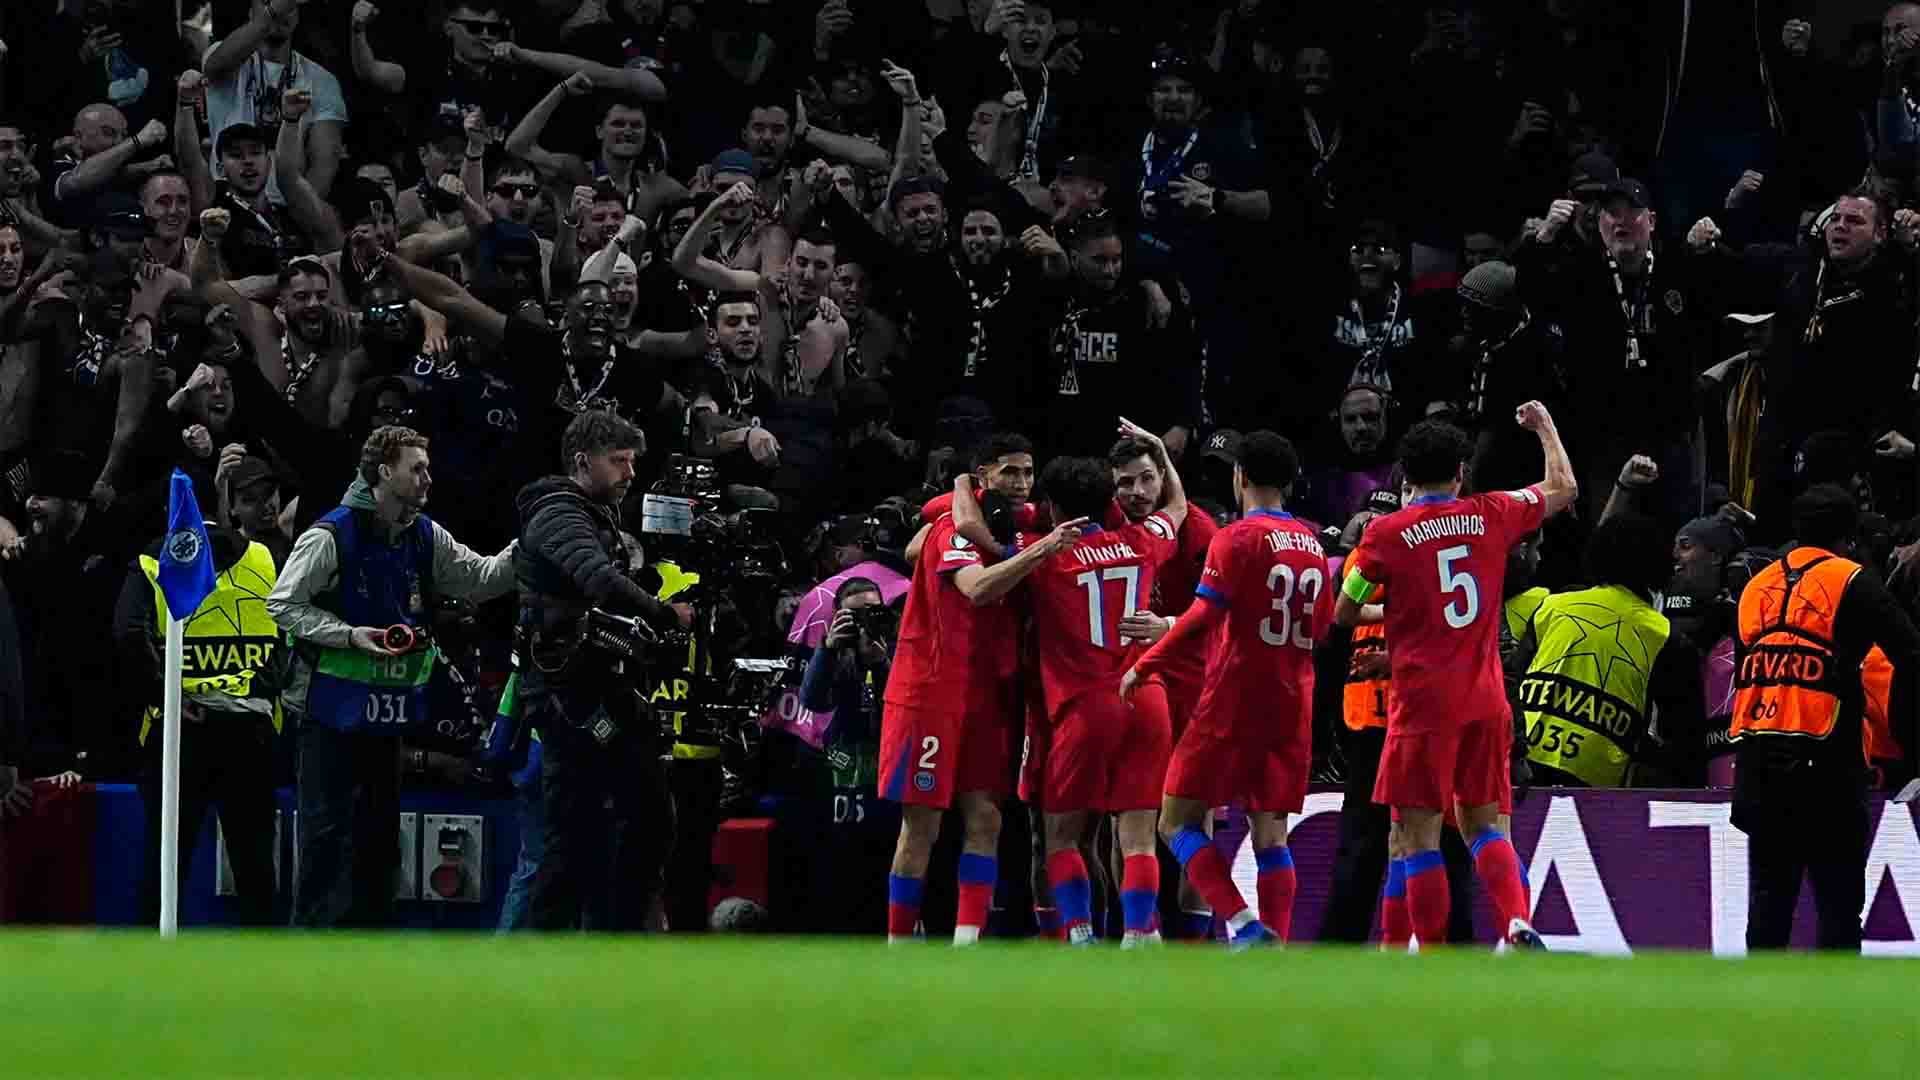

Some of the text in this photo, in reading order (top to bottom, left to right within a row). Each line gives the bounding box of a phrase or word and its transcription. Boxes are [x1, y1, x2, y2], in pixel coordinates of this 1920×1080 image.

[1400, 514, 1485, 549] MARQUINHOS
[1436, 544, 1478, 629] 5
[1076, 565, 1140, 648] 17
[1259, 563, 1324, 651] 33
[366, 693, 408, 724] 031
[918, 735, 940, 769] 2
[1527, 720, 1585, 759] 035
